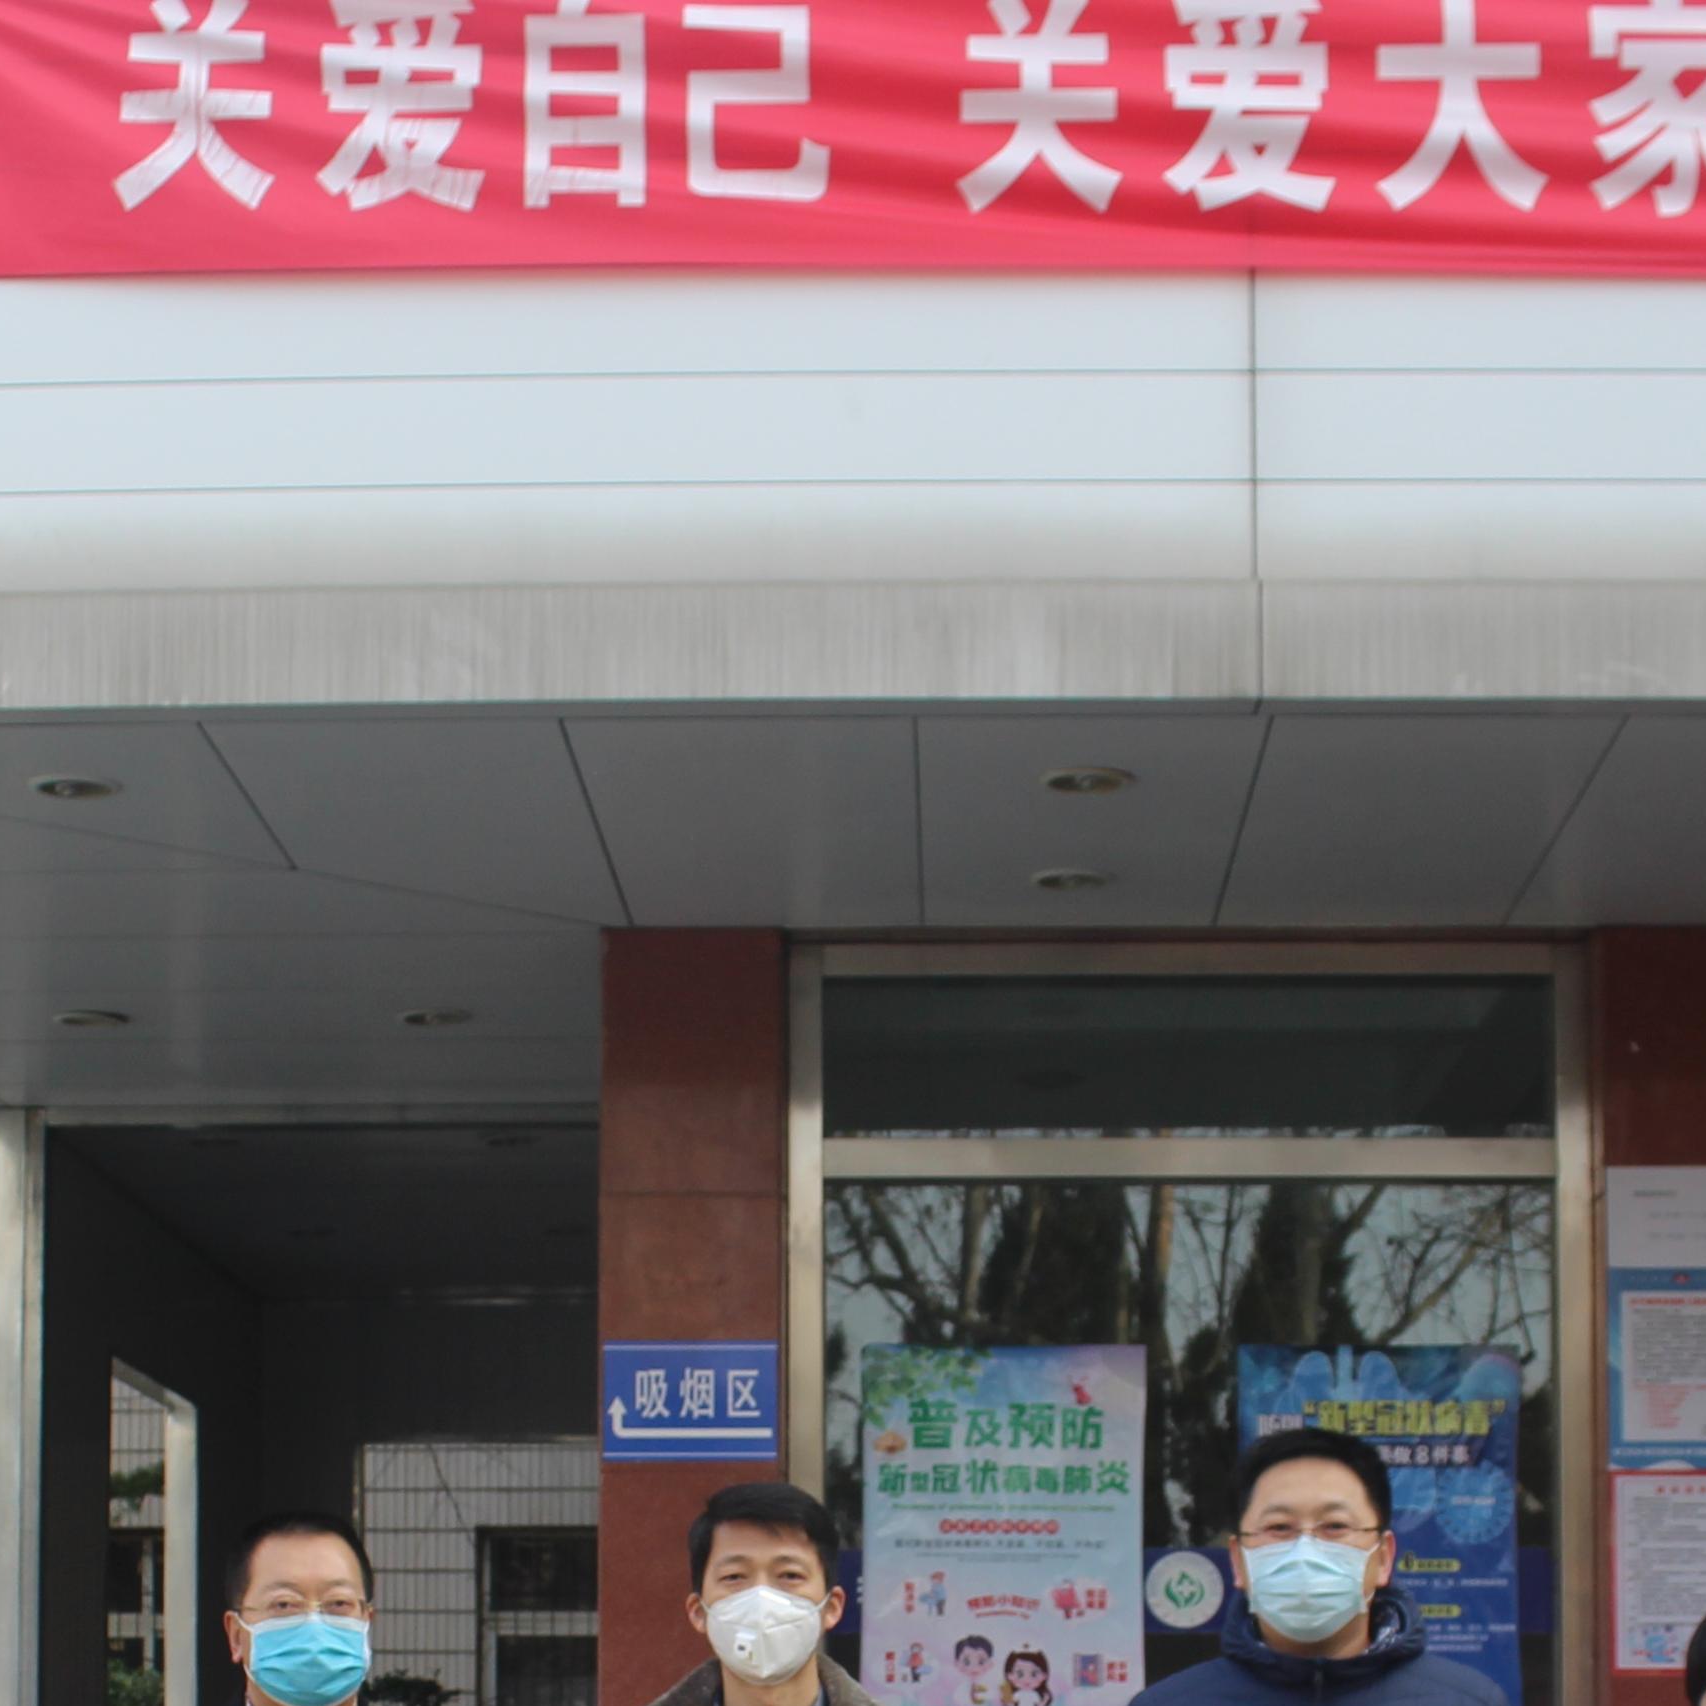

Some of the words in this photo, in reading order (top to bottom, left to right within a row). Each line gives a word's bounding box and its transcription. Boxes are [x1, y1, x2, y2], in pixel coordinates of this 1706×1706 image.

[112, 0, 830, 212] 关爱自己
[634, 1366, 762, 1420] 吸烟区
[908, 1398, 1104, 1450] 普及预防
[877, 1457, 1131, 1498] 新型冠状病毒肺炎
